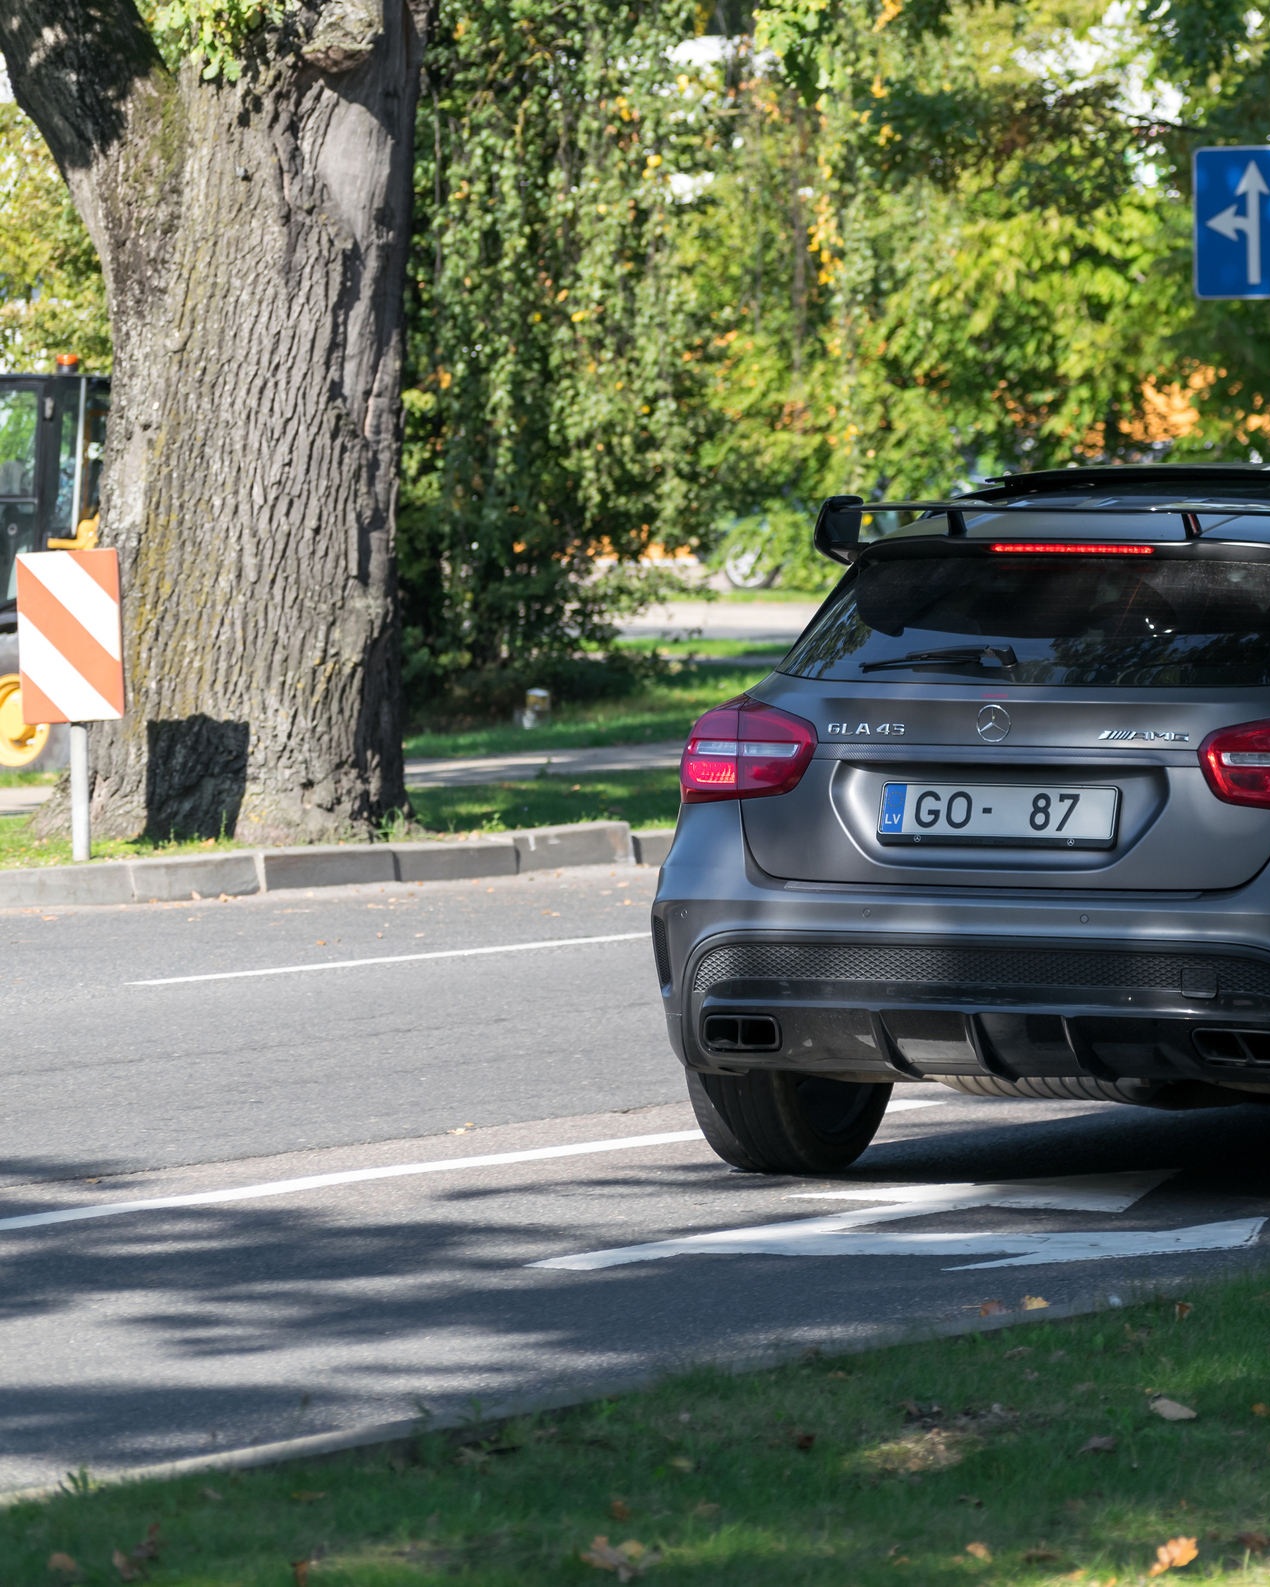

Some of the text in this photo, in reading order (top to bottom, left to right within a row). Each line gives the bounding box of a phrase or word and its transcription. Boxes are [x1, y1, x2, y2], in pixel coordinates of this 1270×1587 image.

[827, 722, 905, 736] GLA 45
[1131, 730, 1190, 742] AMG
[1029, 792, 1081, 832] 87
[885, 813, 901, 825] LV
